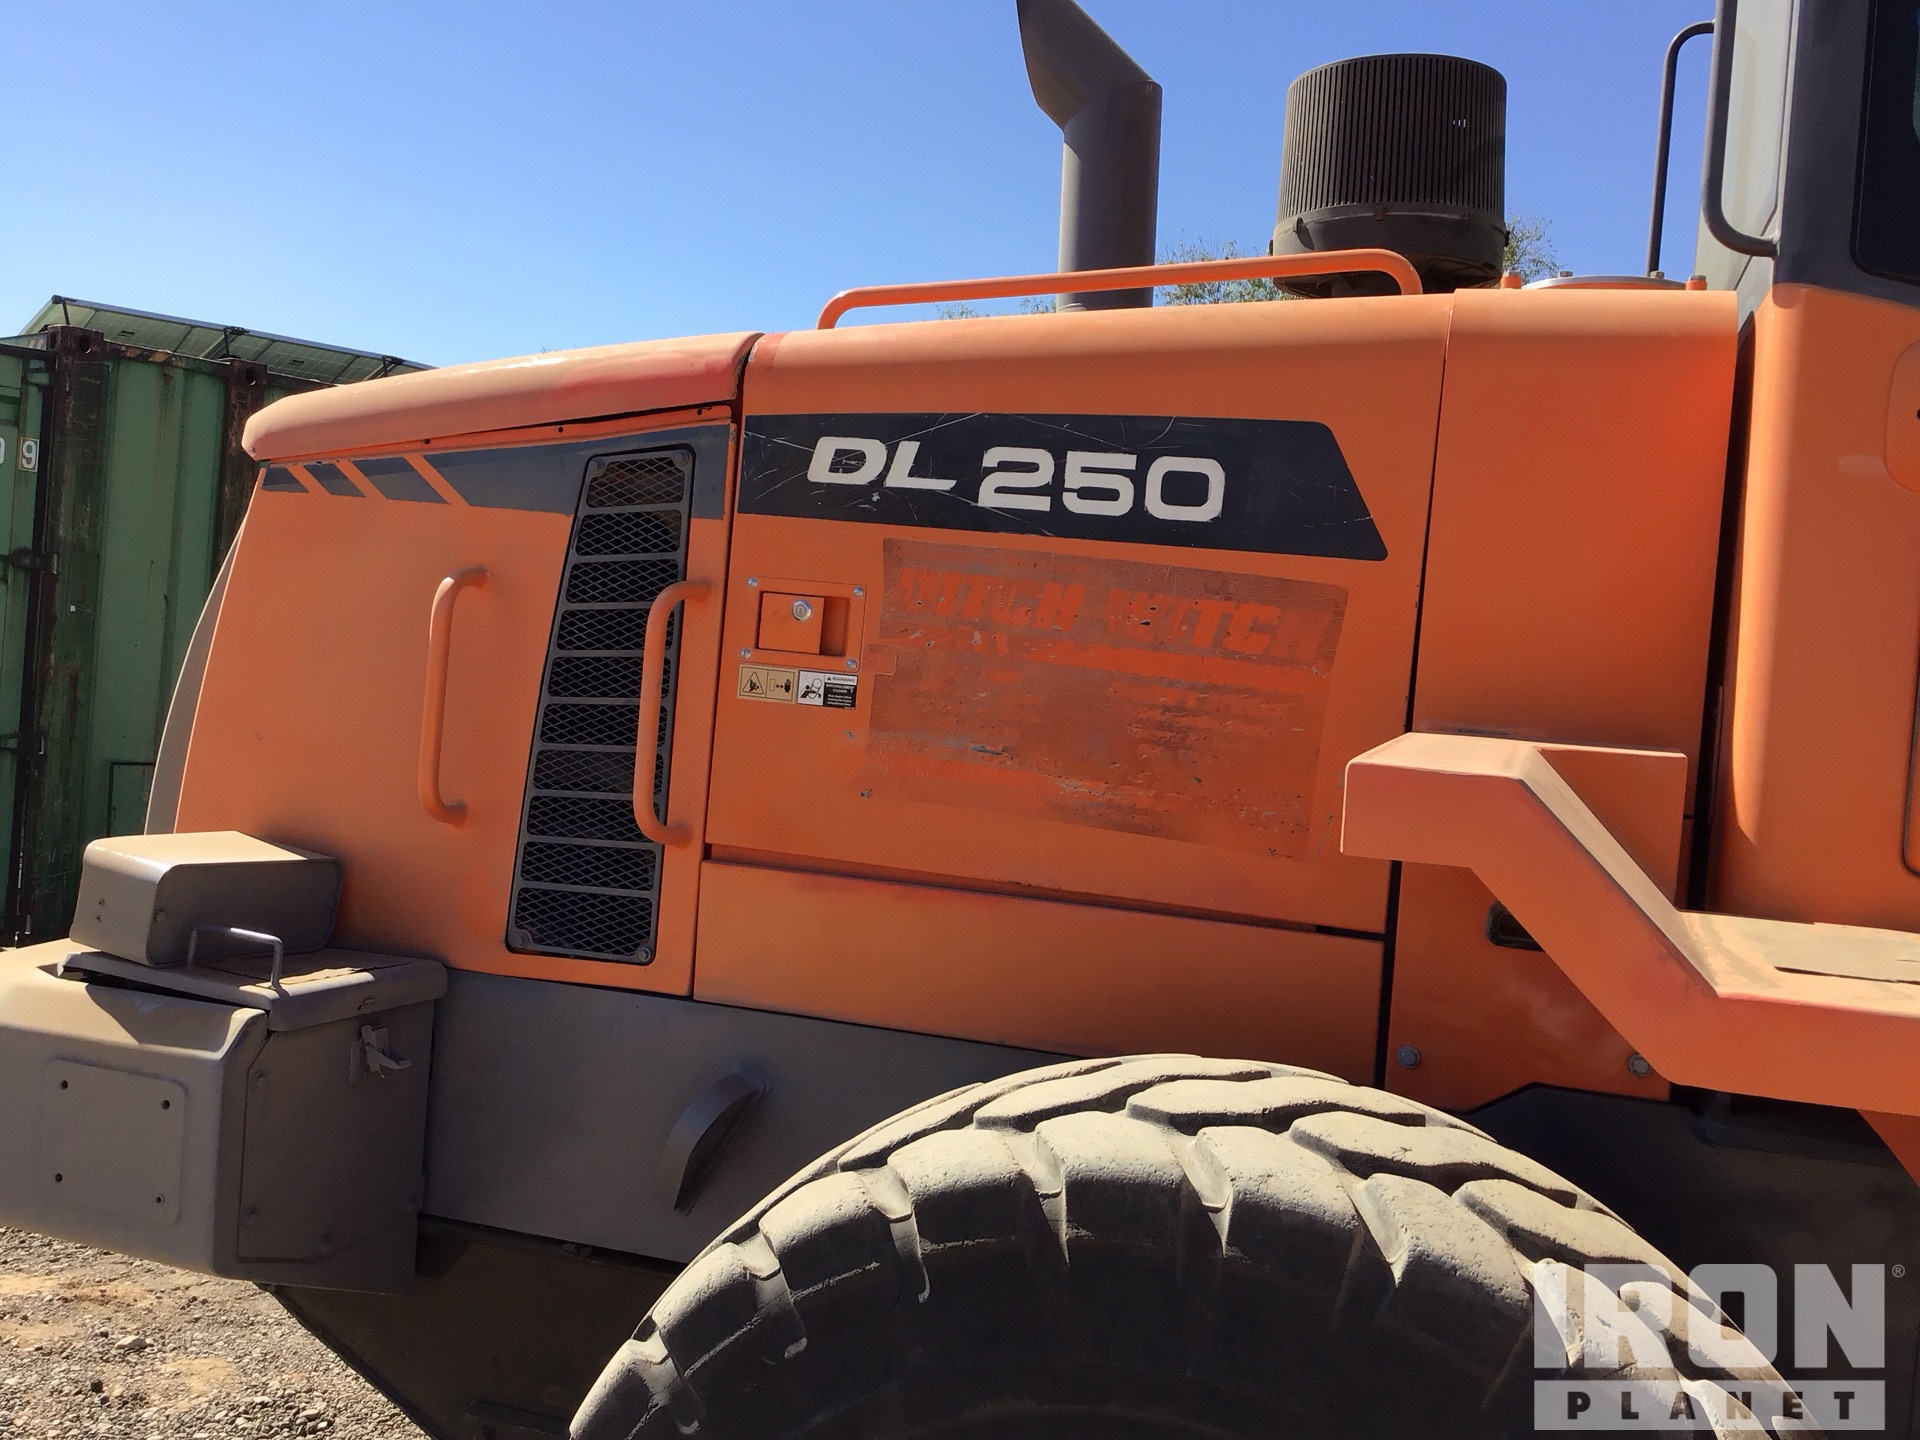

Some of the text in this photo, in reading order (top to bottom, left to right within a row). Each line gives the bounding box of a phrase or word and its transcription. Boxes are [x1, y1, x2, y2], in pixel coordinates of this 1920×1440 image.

[22, 441, 37, 469] 9
[807, 437, 1225, 522] DL 250
